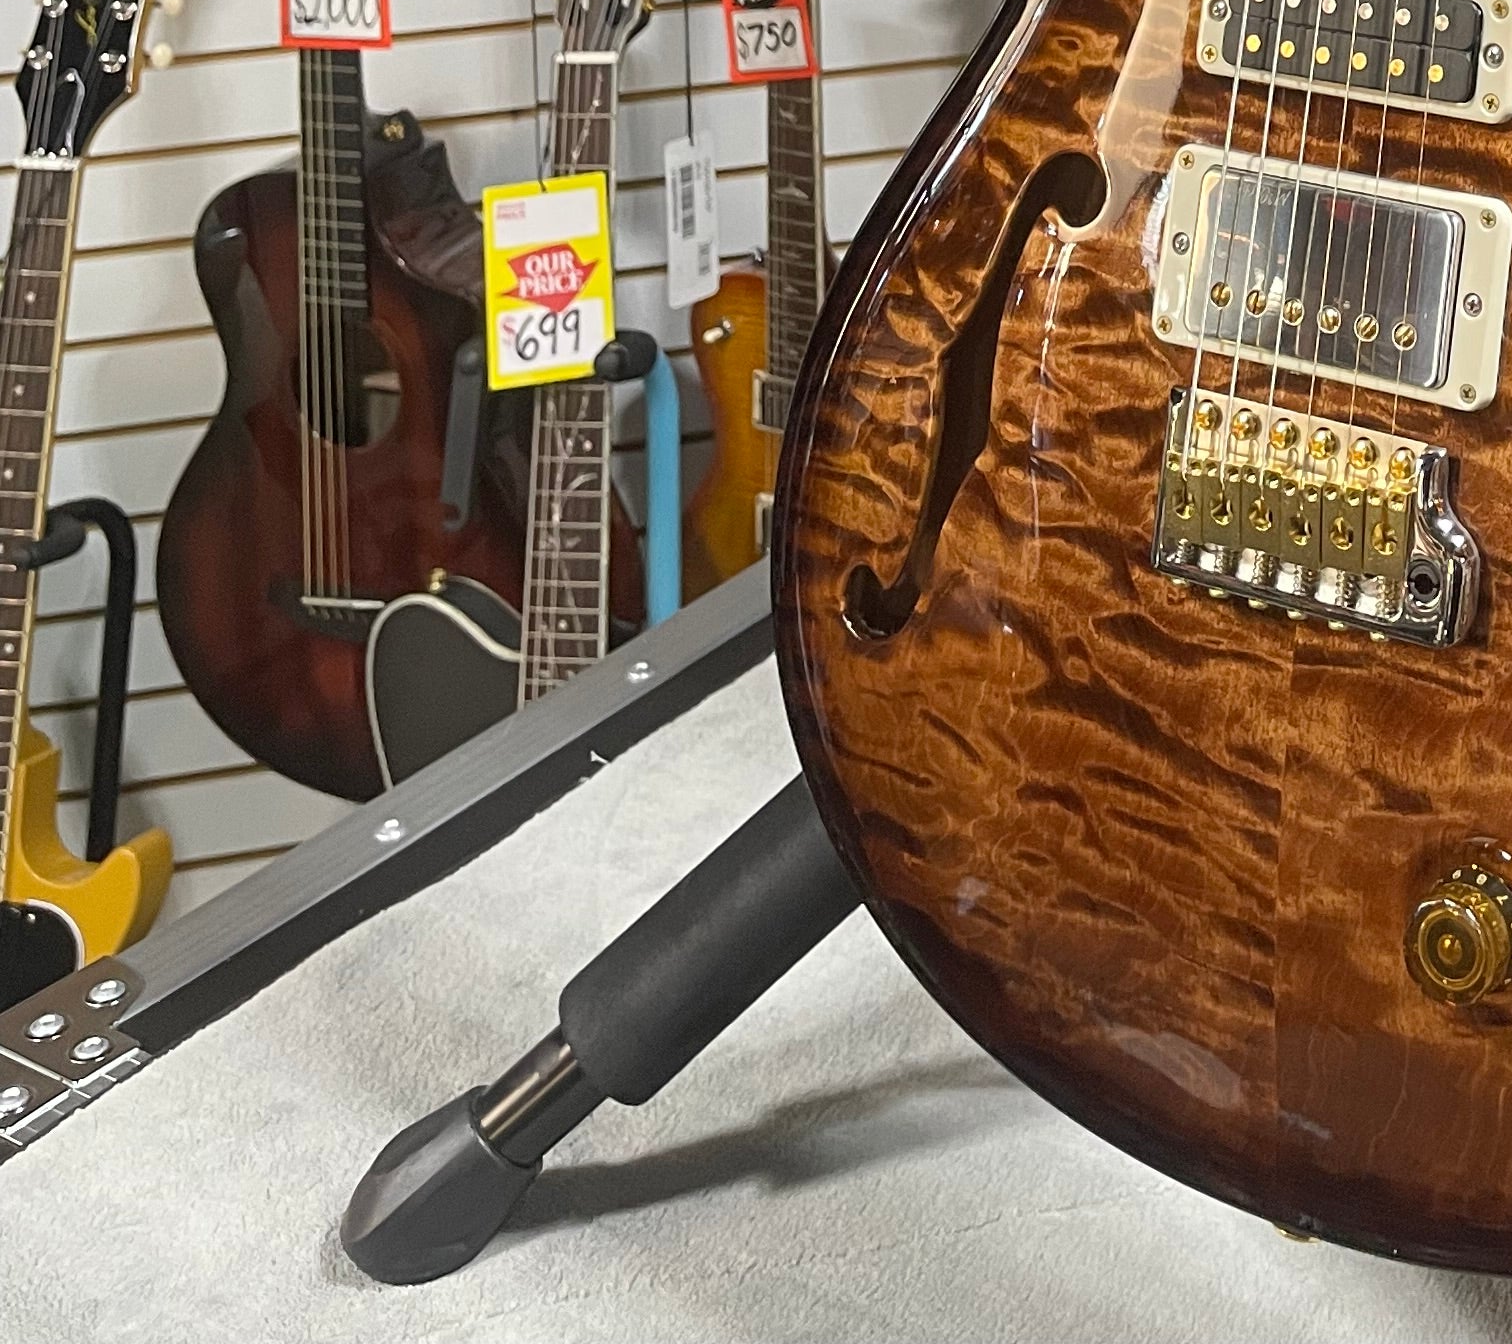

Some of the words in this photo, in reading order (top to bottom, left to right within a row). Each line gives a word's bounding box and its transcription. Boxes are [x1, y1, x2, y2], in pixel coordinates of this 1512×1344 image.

[736, 20, 797, 60] $750
[524, 250, 575, 273] OUR
[517, 270, 584, 298] PRICE
